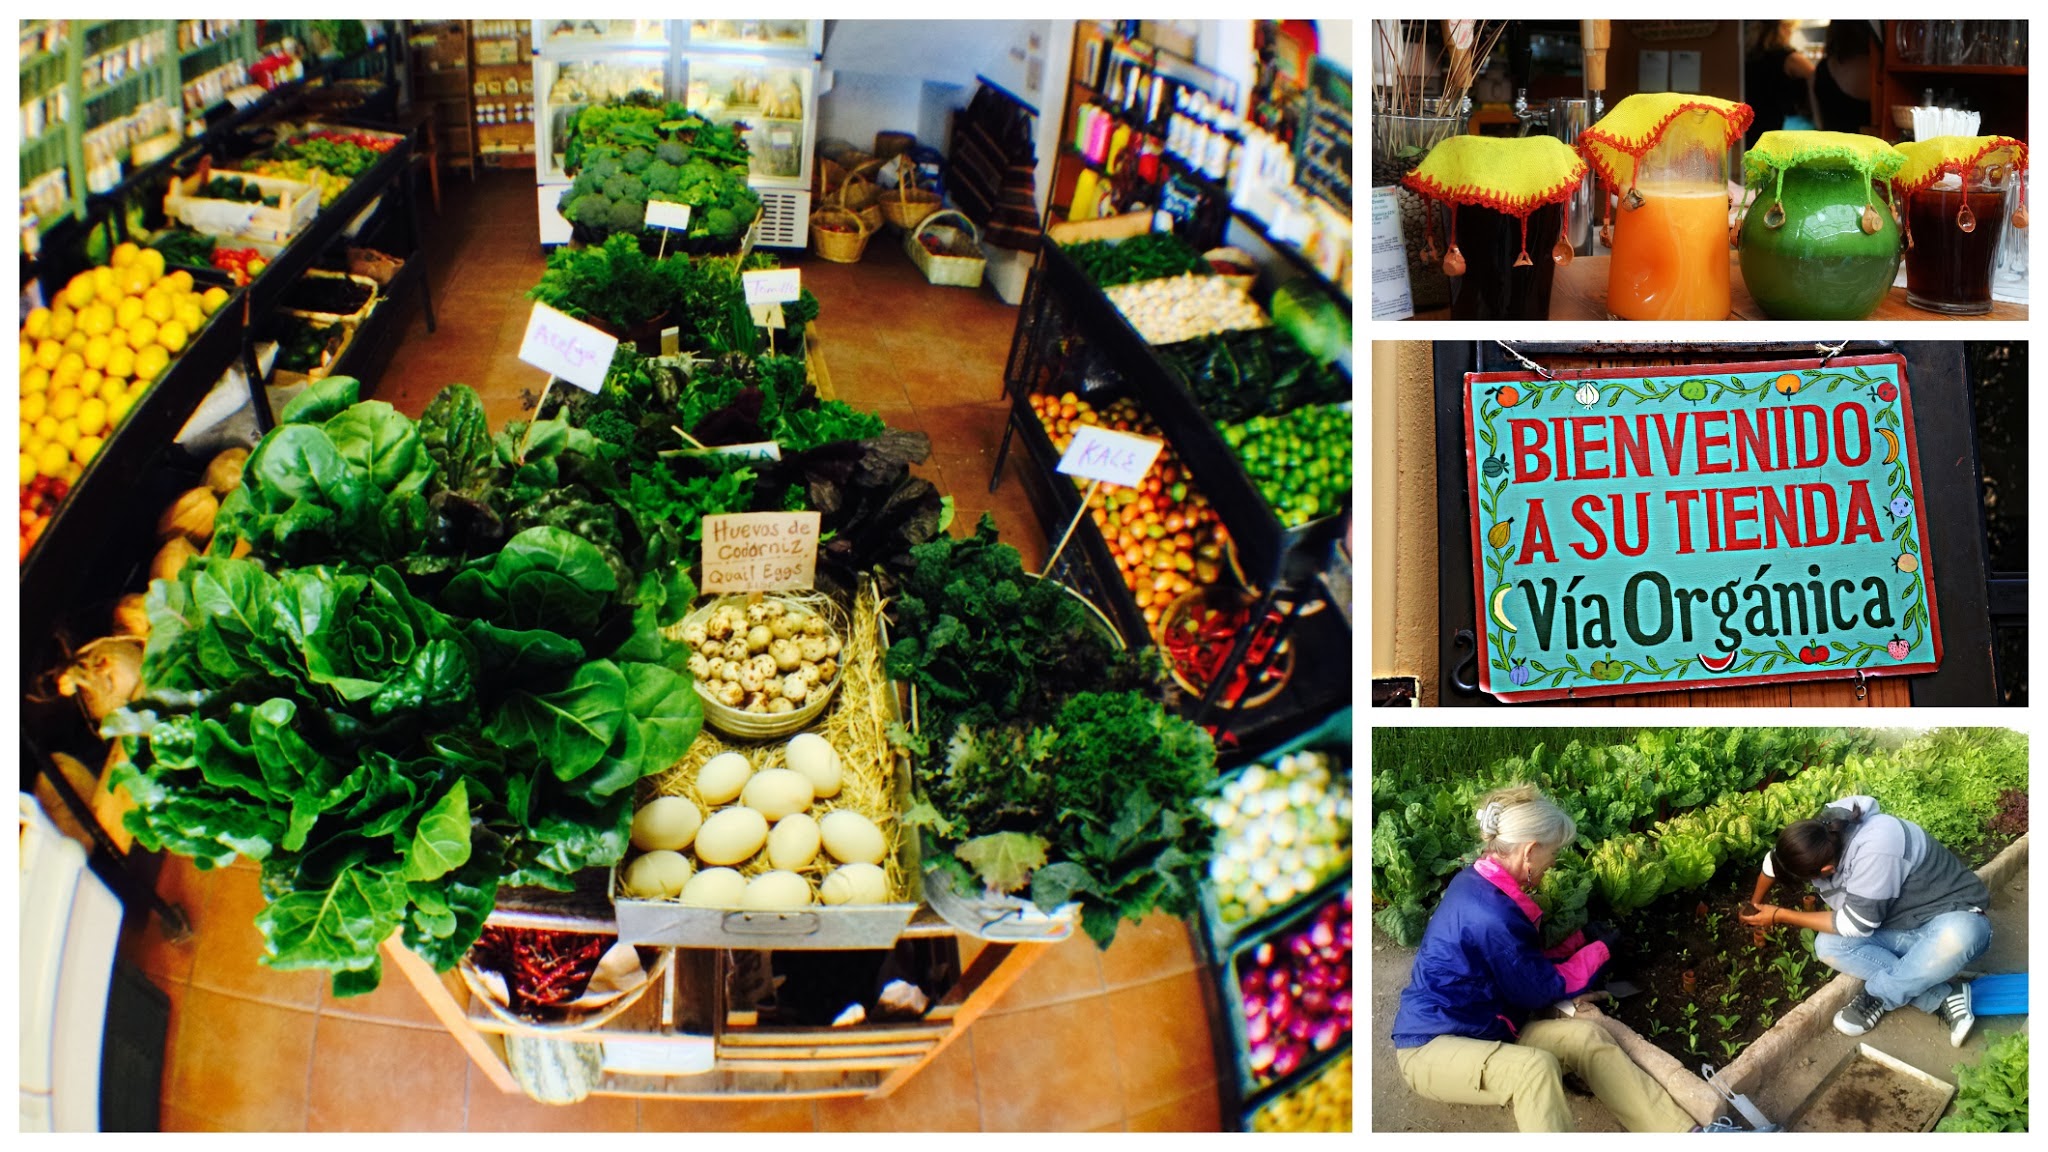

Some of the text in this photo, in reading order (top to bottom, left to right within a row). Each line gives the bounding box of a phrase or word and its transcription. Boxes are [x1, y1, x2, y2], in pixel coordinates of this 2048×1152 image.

[1077, 438, 1136, 473] KALE
[1508, 401, 1871, 484] BIENVENIDO
[714, 519, 811, 542] Huevos de
[1514, 480, 1884, 565] A SU TIENDA
[709, 563, 803, 583] Quail Eggs
[1517, 563, 1895, 653] Vía Orgánica
